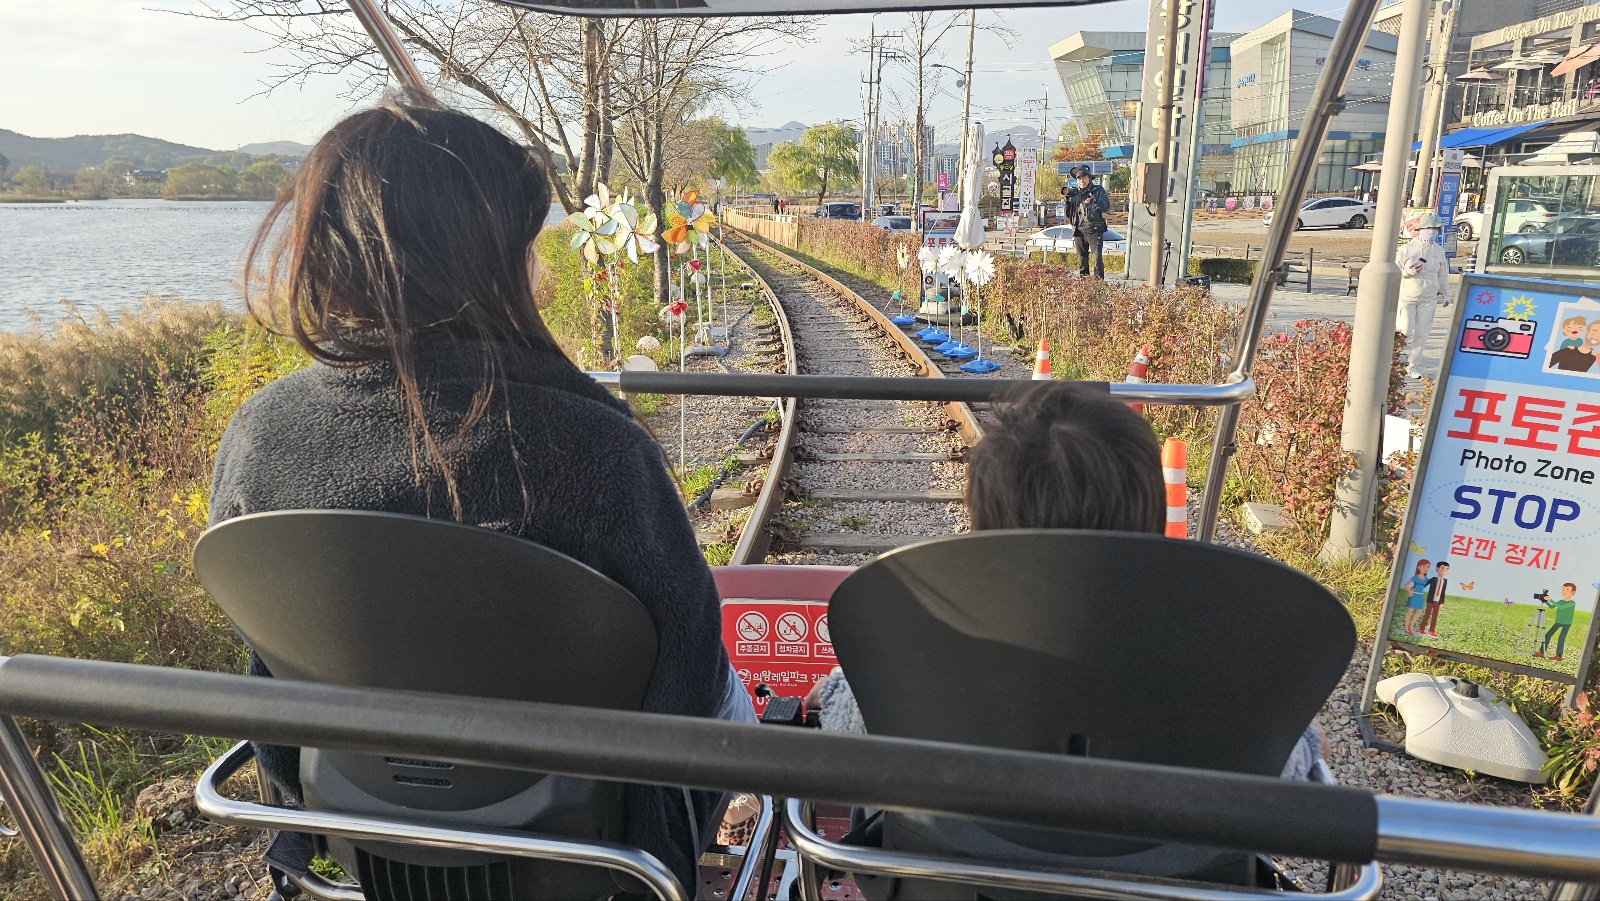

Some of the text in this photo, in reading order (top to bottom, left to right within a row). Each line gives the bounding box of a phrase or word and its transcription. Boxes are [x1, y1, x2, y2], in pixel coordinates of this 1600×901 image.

[1500, 24, 1531, 43] Coffee
[1535, 18, 1551, 34] On
[1554, 11, 1575, 30] The
[1473, 99, 1578, 127] Coffee On The Rail
[1442, 181, 1457, 192] GS25
[1447, 388, 1600, 458] 포토존
[1460, 449, 1595, 484] Photo Zone
[1450, 484, 1581, 533] STOP
[1450, 534, 1560, 571] 잠깐 정지!
[779, 645, 806, 654] 정차금지
[752, 670, 808, 683] 의왕레일파크
